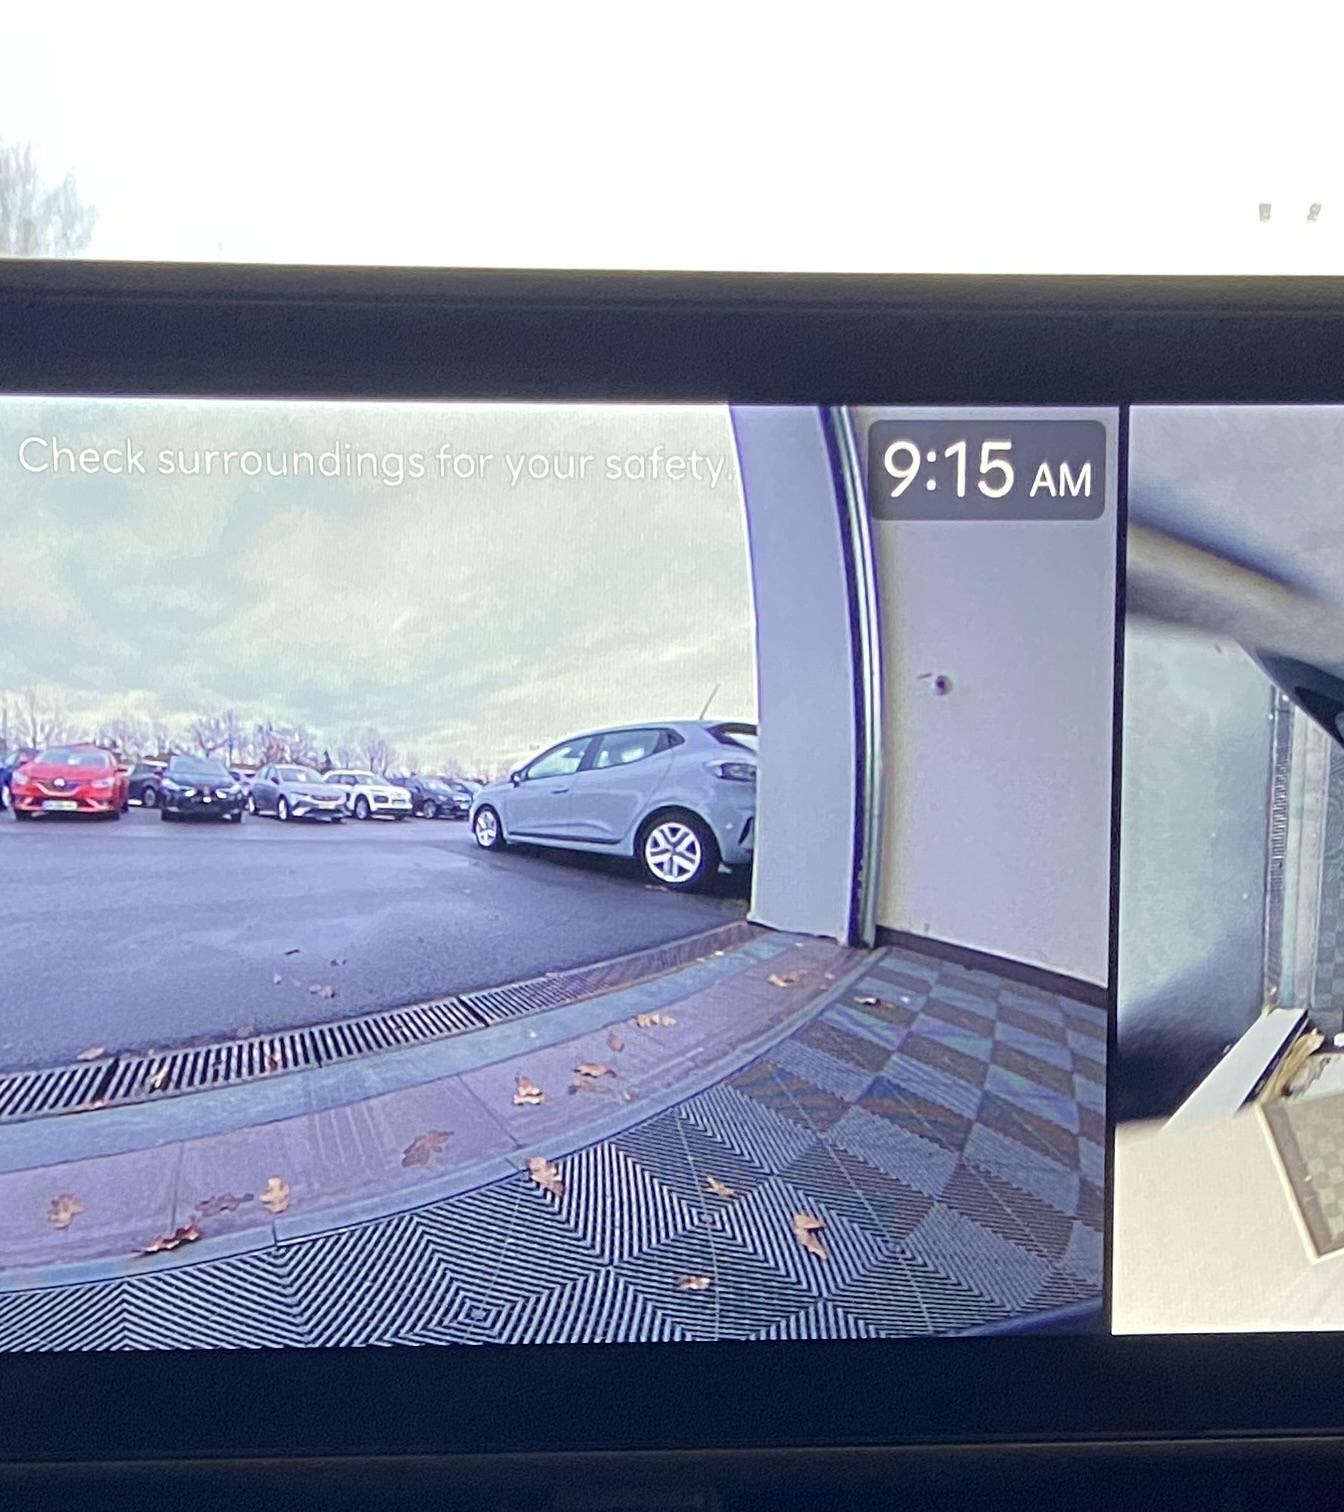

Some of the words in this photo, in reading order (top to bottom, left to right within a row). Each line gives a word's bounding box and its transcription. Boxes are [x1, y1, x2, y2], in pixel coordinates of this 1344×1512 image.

[18, 436, 145, 474] Check
[158, 438, 426, 486] surroundings
[436, 443, 494, 478] for
[506, 452, 594, 487] your
[605, 446, 733, 488] safety.
[884, 440, 1015, 498] 9:15
[1029, 462, 1092, 498] AM
